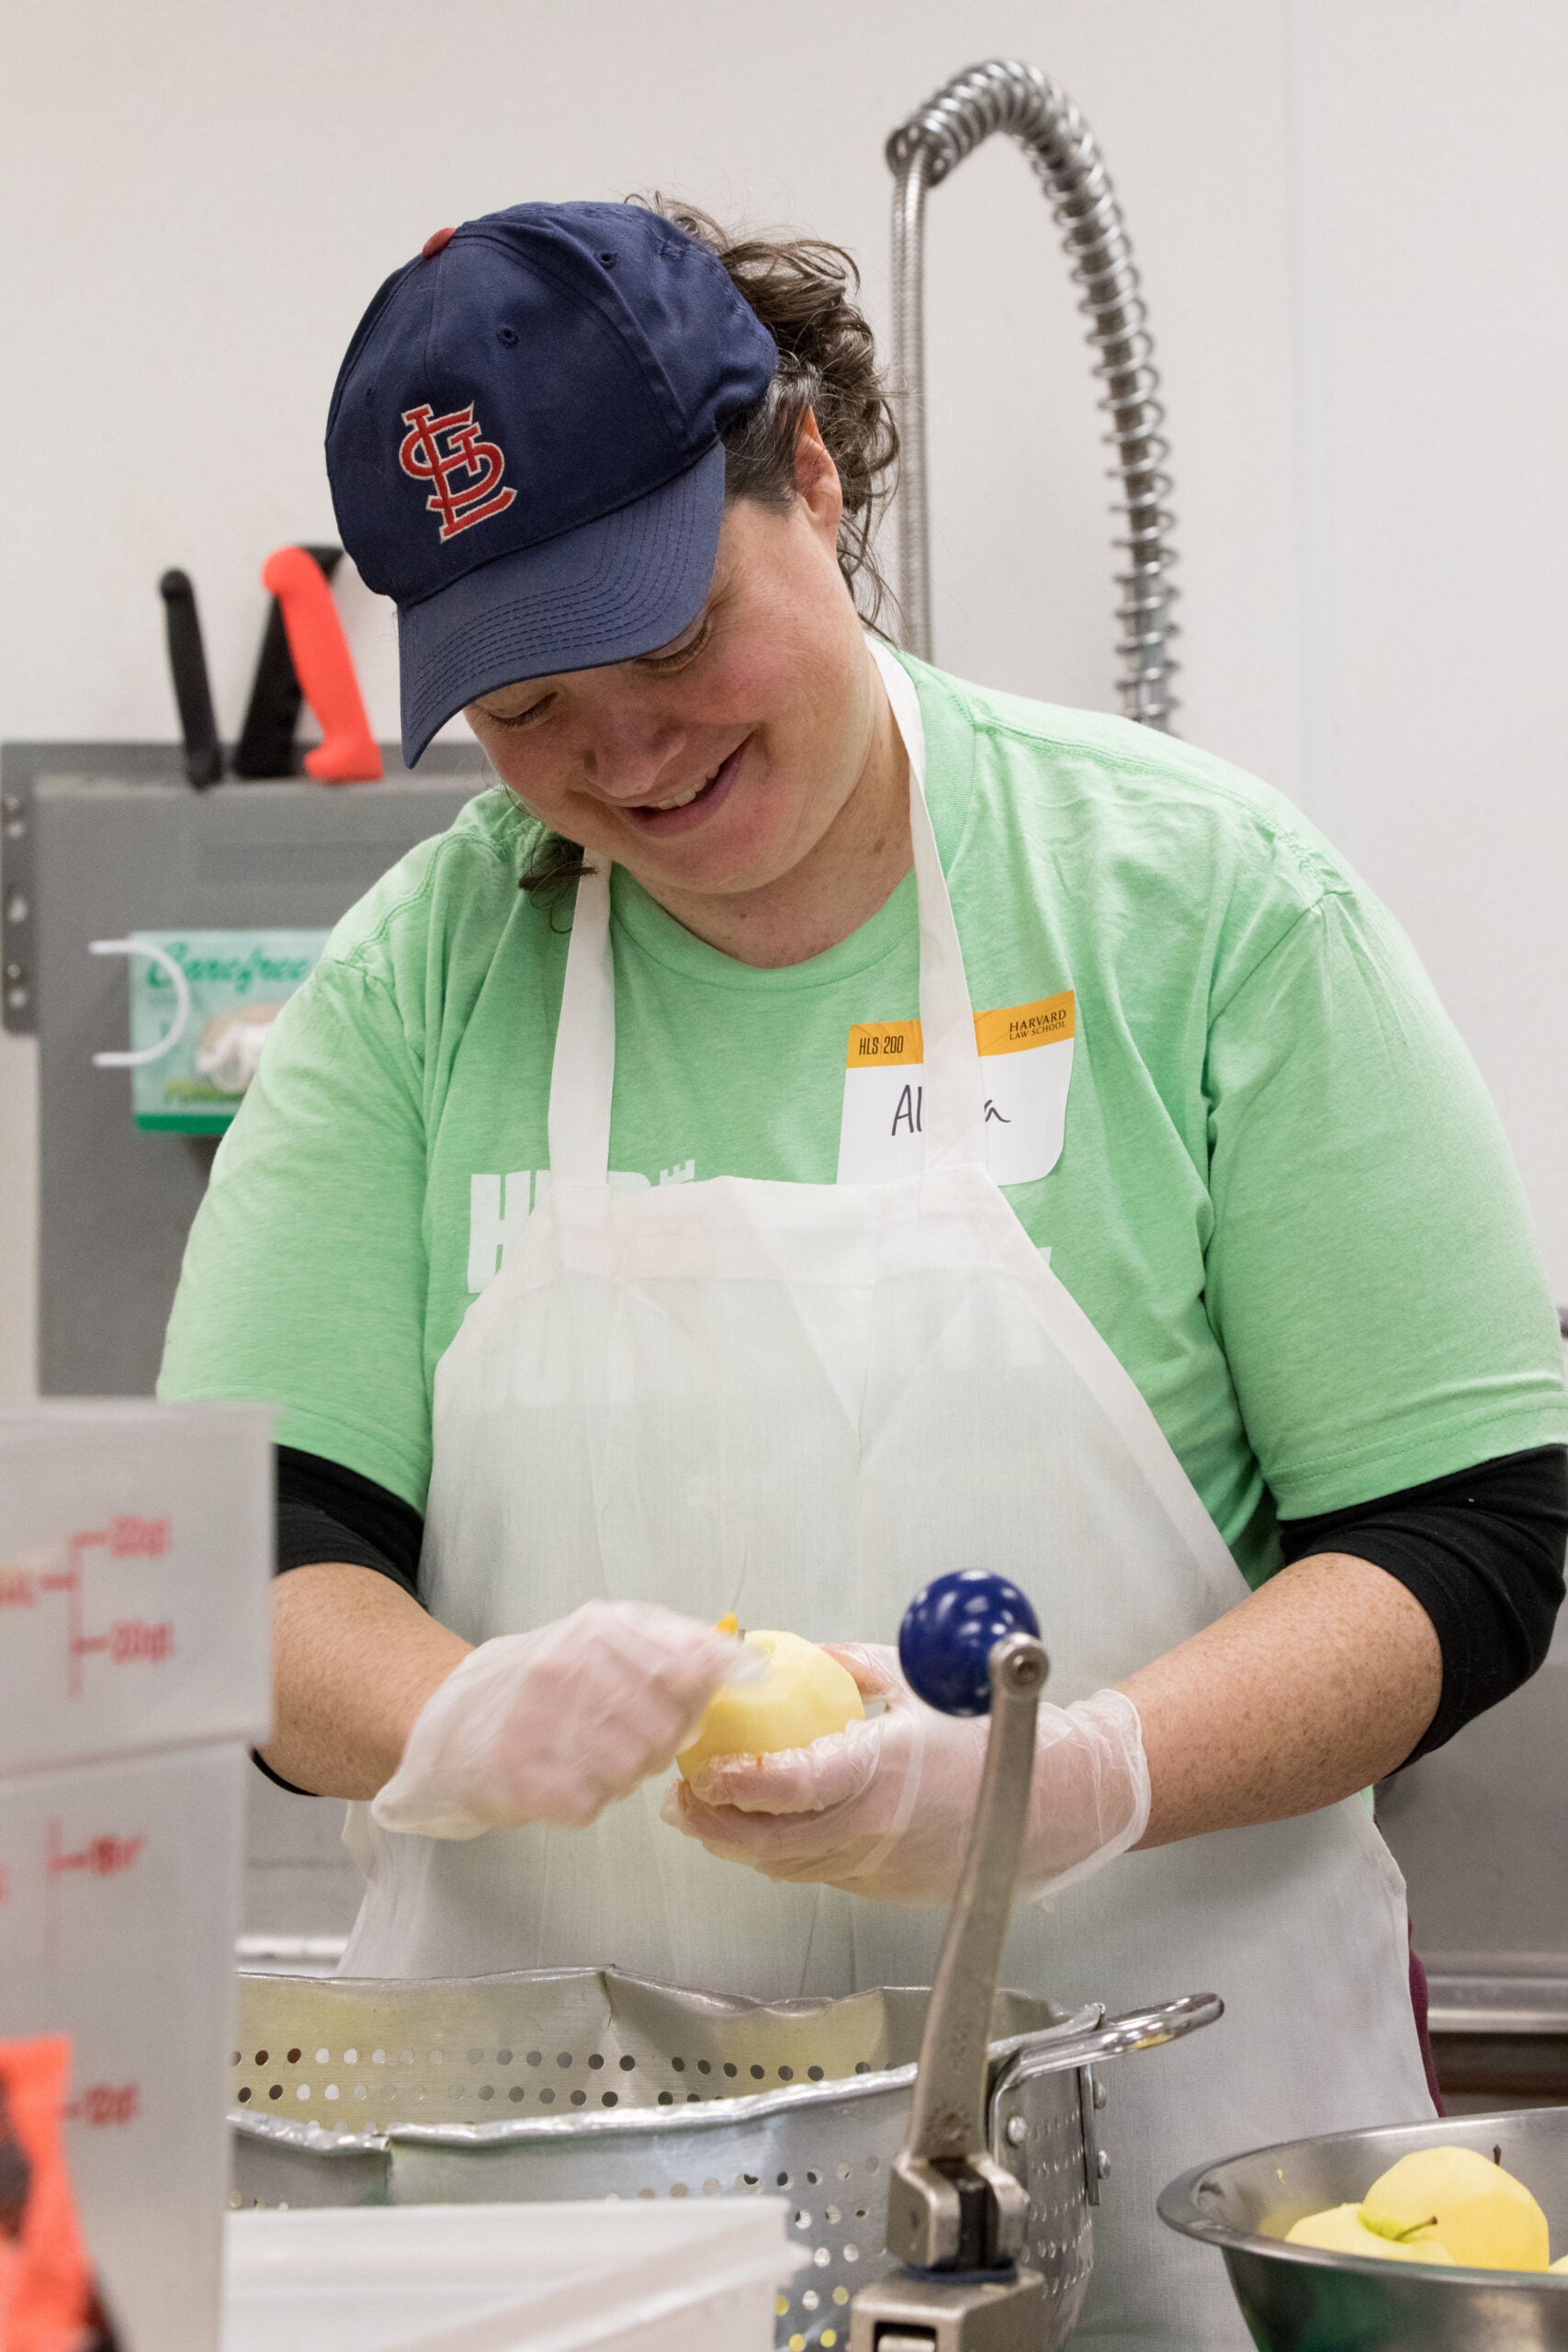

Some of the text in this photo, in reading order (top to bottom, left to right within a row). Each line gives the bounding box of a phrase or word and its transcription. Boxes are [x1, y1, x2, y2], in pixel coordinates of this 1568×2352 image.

[1009, 1009, 1067, 1033] HARVARD
[1009, 1020, 1066, 1041] LAW SCHOOL
[858, 1035, 904, 1056] HLS 200
